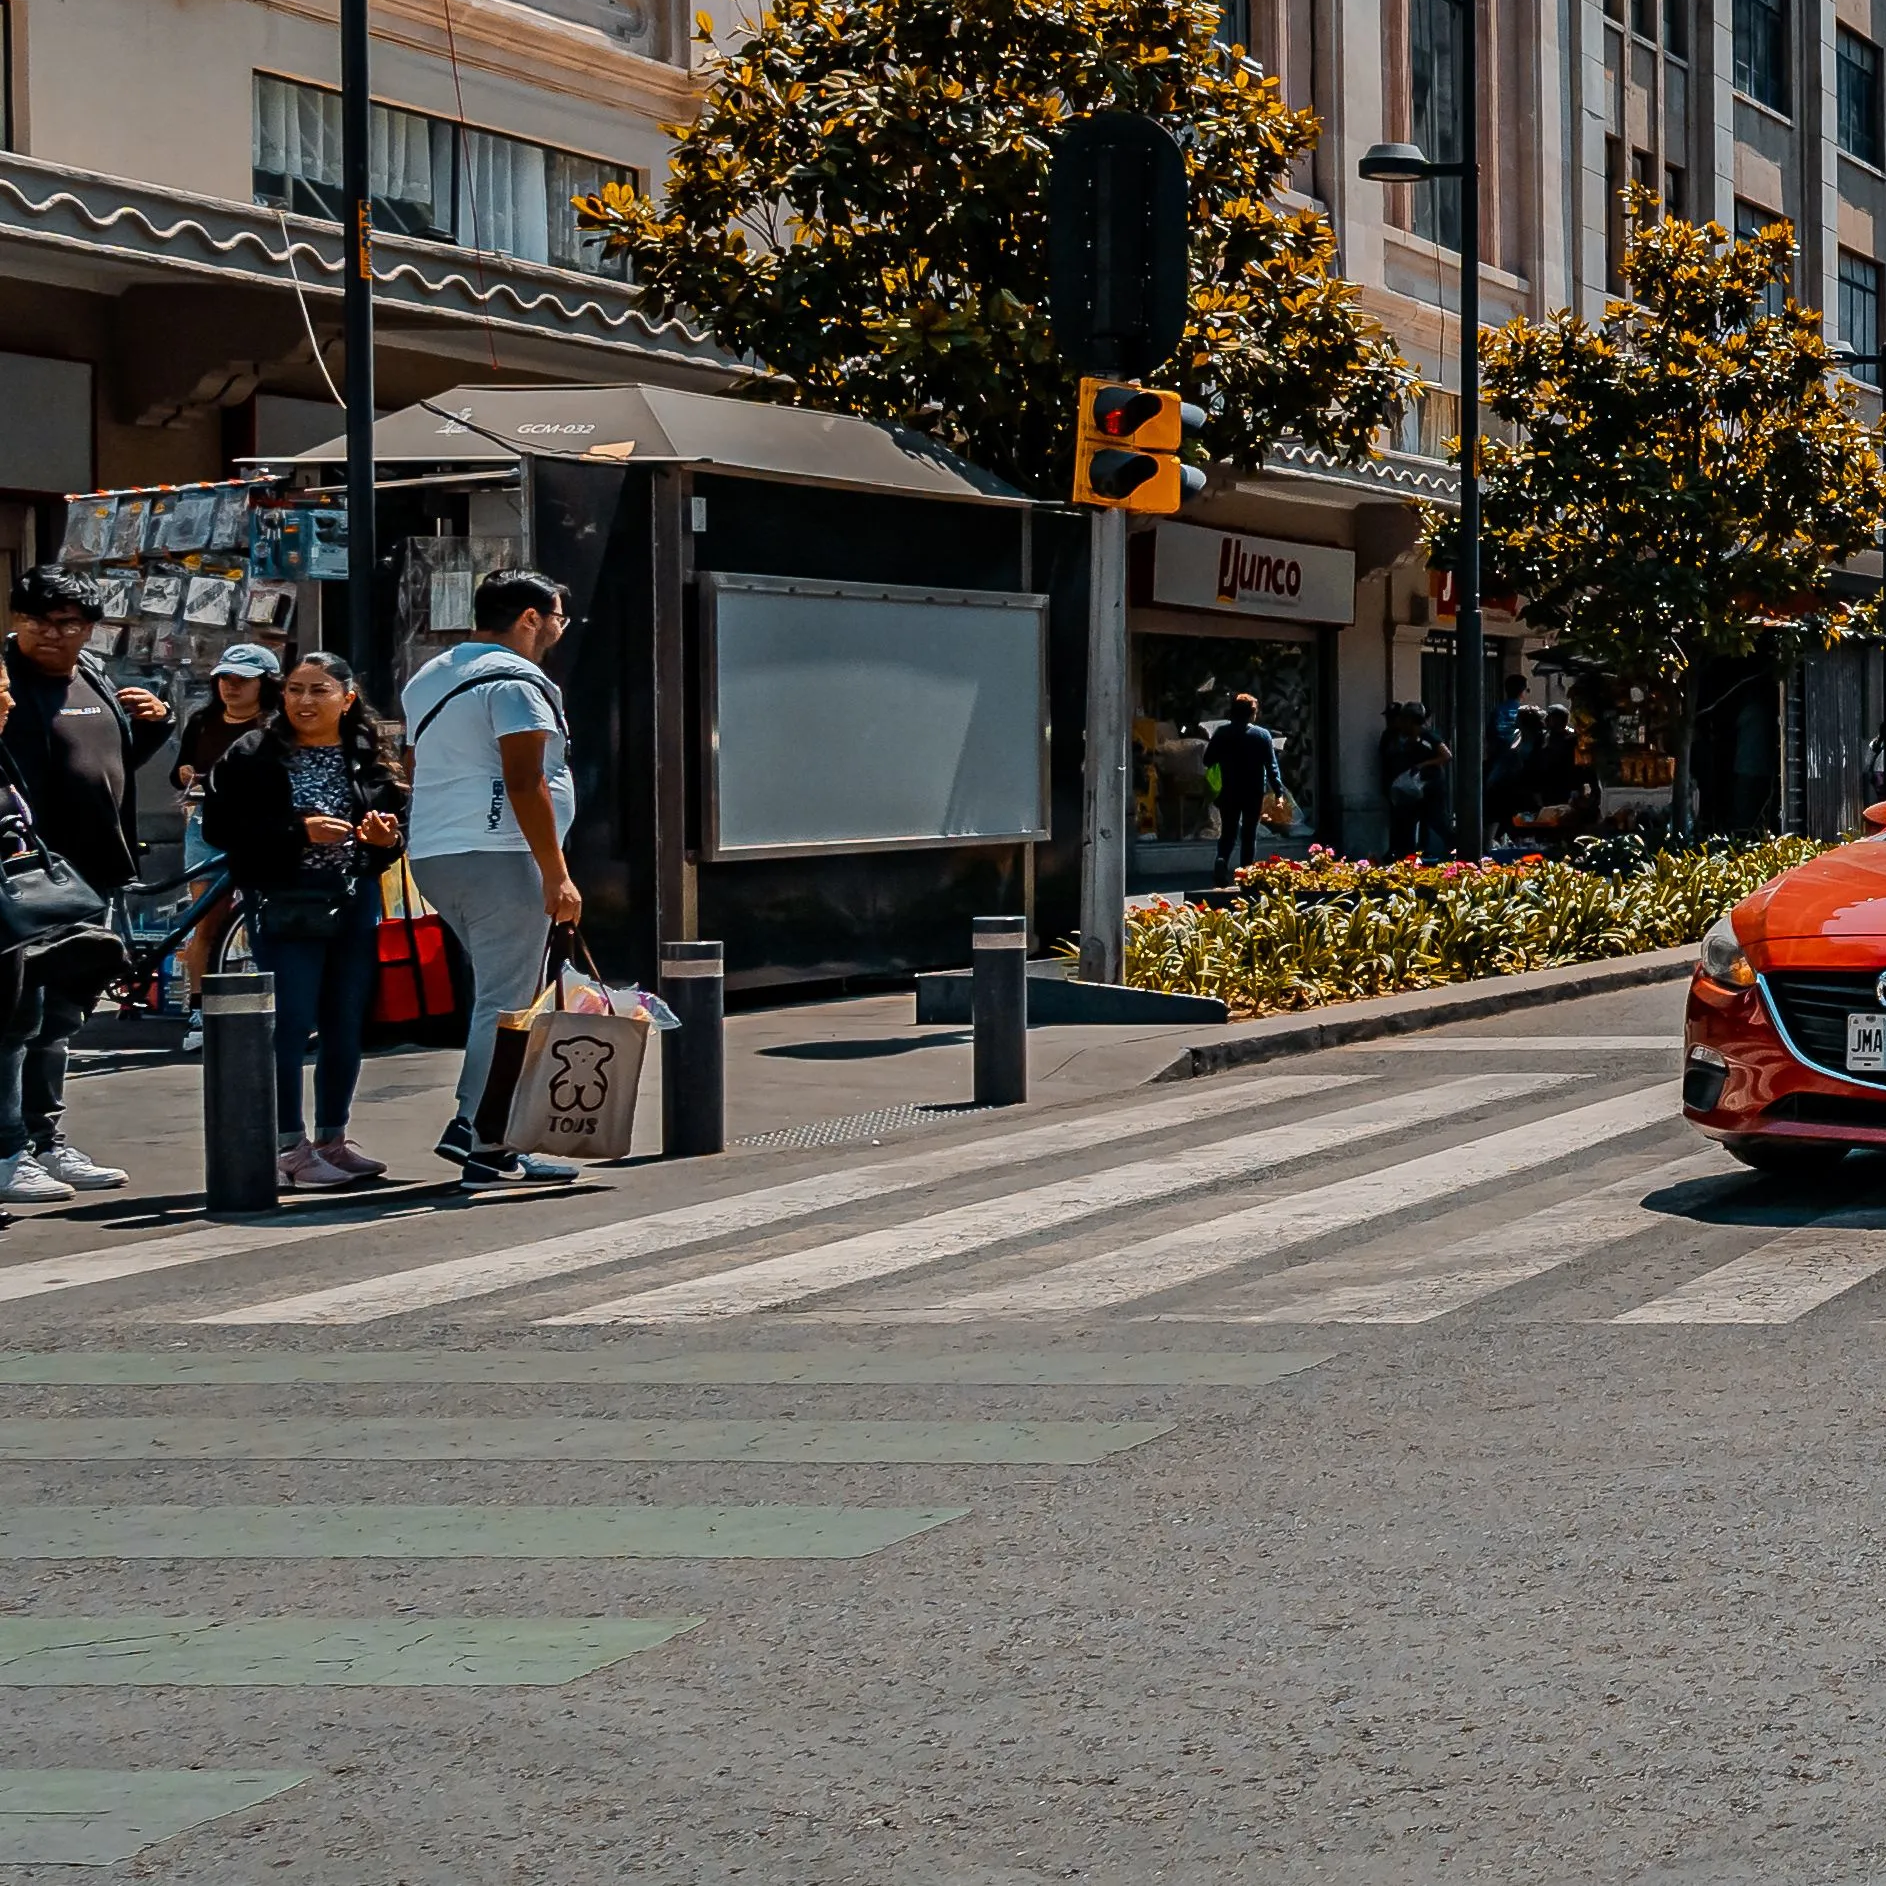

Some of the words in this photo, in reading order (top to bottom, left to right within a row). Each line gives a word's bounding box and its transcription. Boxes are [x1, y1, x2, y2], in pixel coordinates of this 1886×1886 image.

[516, 422, 596, 434] GCM-032
[1217, 537, 1302, 601] Junco
[547, 1114, 600, 1135] TOUS
